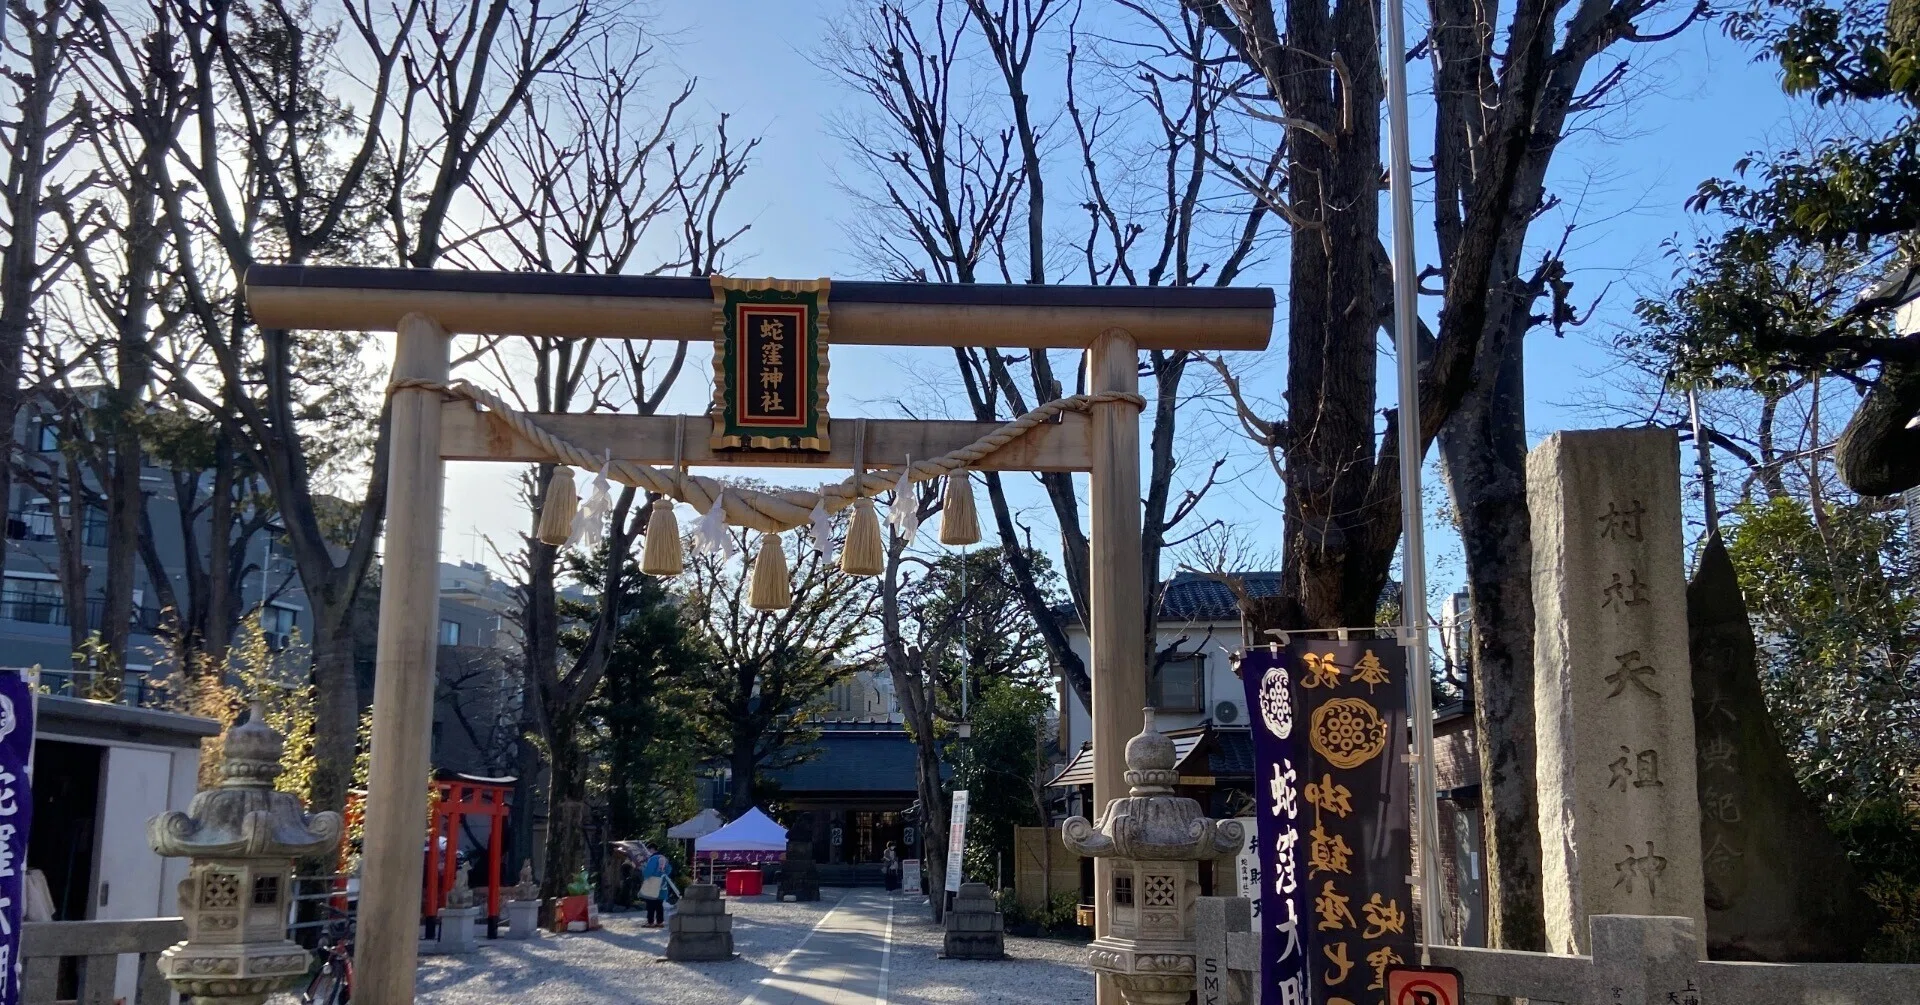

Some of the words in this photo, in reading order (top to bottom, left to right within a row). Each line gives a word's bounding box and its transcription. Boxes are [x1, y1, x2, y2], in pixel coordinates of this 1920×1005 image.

[760, 319, 784, 413] 蛇窪神社
[1598, 499, 1668, 900] 村社天祖神
[722, 852, 774, 862] おみくじ所
